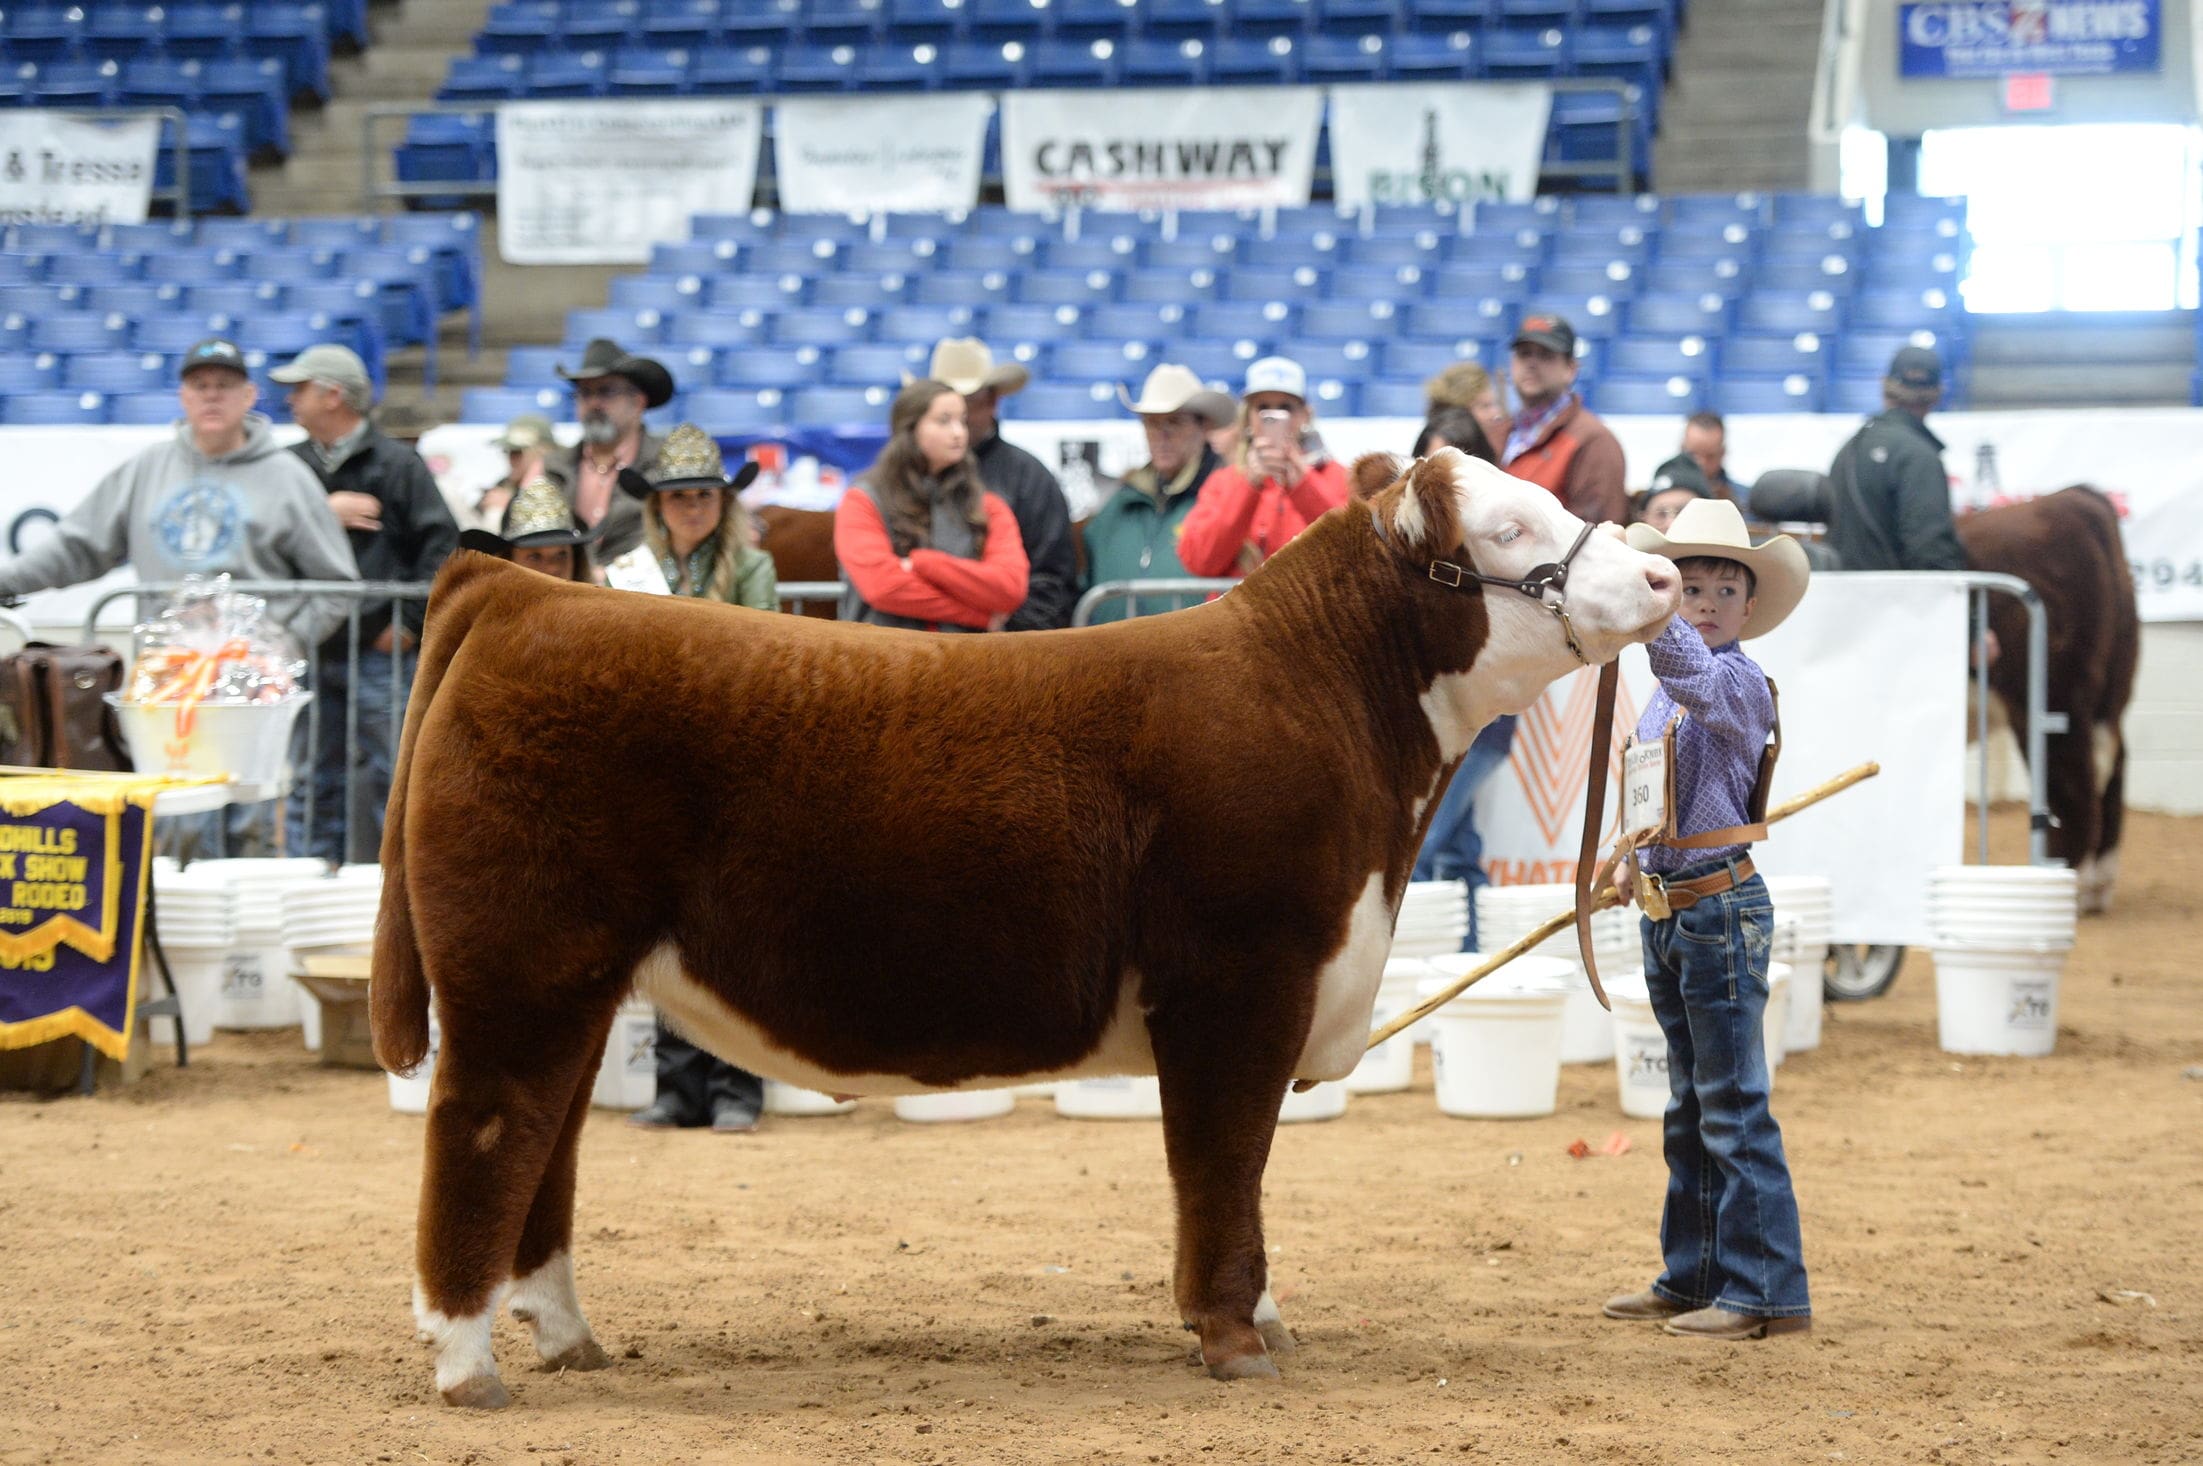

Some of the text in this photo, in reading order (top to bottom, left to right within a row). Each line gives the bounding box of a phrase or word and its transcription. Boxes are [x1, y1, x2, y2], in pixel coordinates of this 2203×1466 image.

[1907, 3, 2007, 47] CBS
[2050, 2, 2149, 41] NEWS
[5, 150, 25, 182] &
[1036, 135, 1286, 176] CASHWAY
[1632, 784, 1650, 807] 360
[24, 854, 88, 883] SHOW
[12, 880, 87, 911] RODEO
